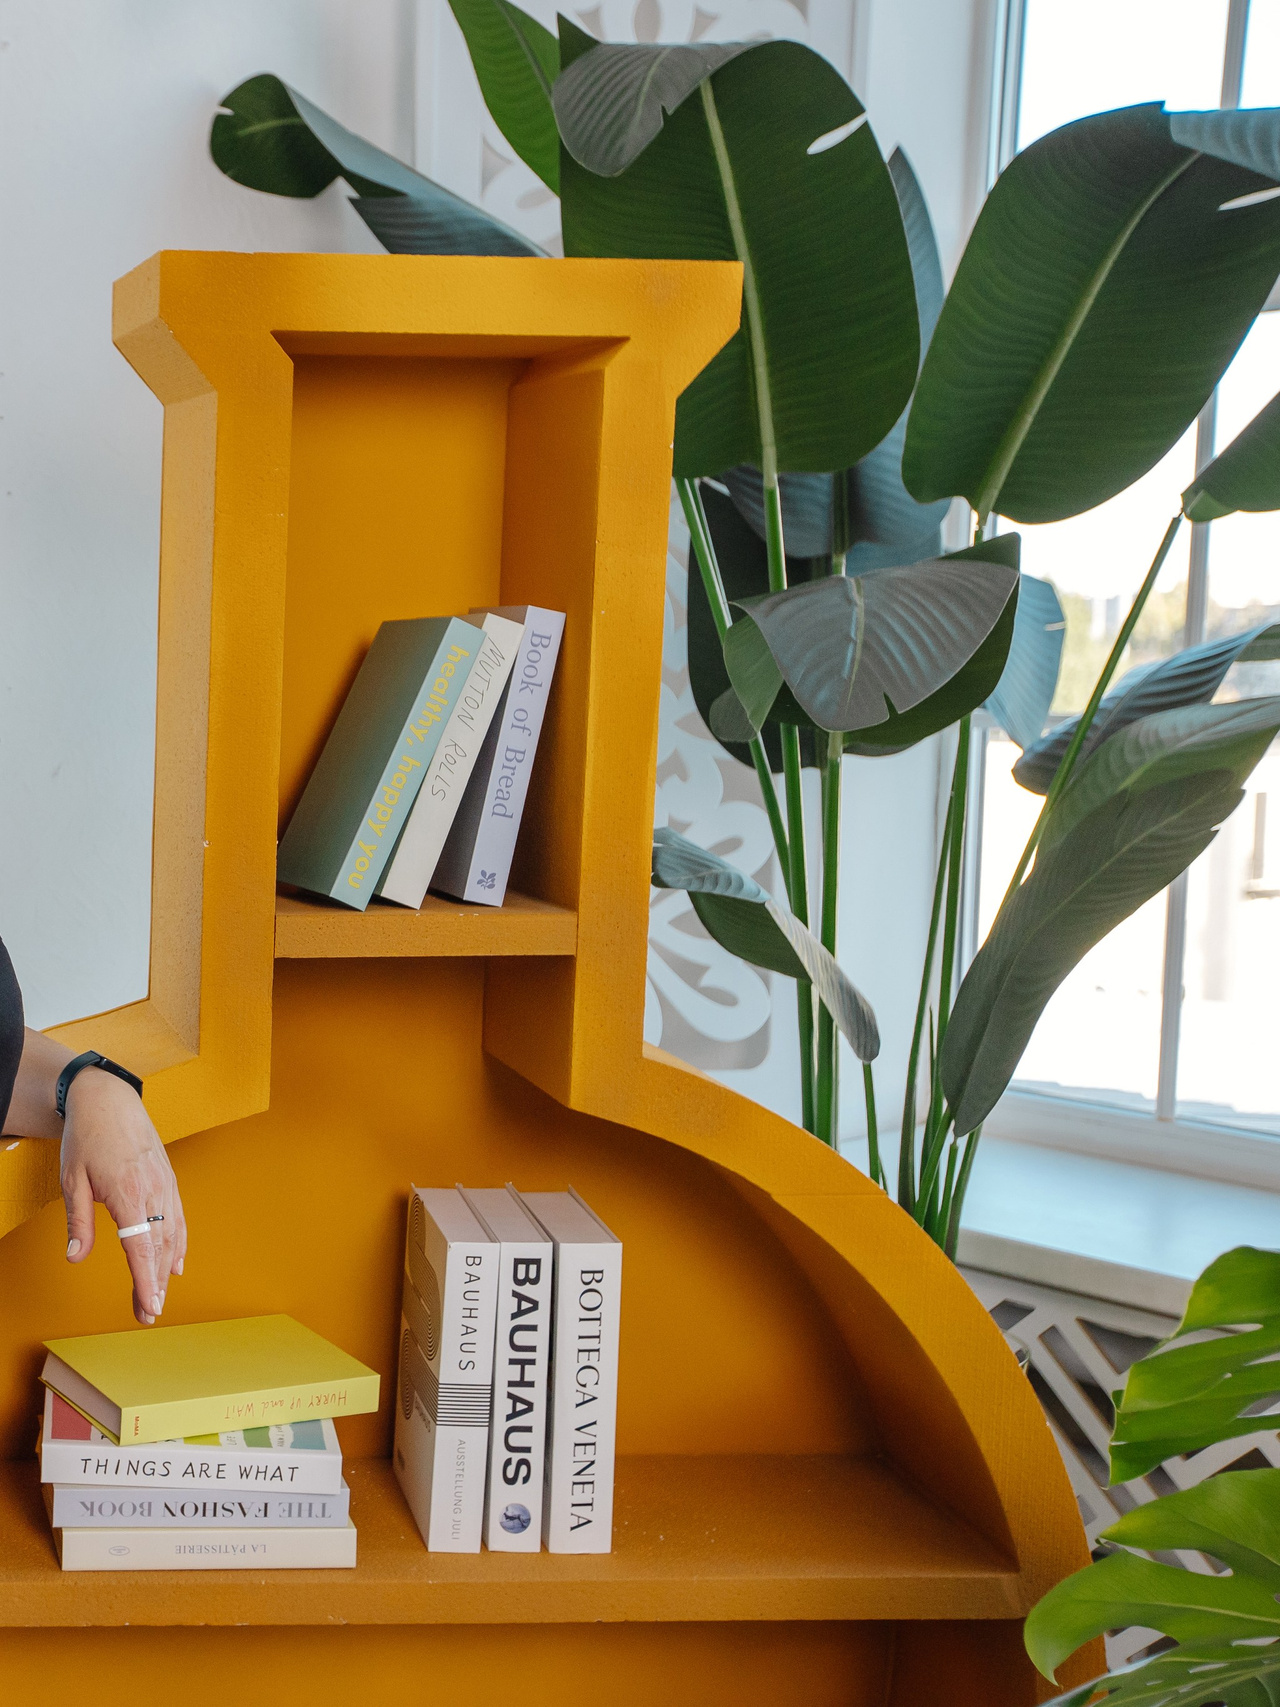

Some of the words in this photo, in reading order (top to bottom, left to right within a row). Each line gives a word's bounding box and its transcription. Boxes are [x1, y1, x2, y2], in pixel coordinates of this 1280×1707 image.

[457, 637, 505, 731] MUTTON
[519, 630, 552, 694] Book
[510, 708, 532, 737] of
[368, 755, 421, 837] happy
[431, 739, 467, 801] ROLLS
[491, 745, 526, 819] Bread
[347, 840, 378, 889] you
[458, 1255, 482, 1371] BAUHAUS
[575, 1269, 604, 1409] BOTTEGA
[290, 1396, 302, 1408] UP
[502, 1257, 542, 1487] BAUHAUS
[261, 1399, 285, 1418] and
[80, 1458, 172, 1477] THINGS
[182, 1462, 227, 1480] ARE
[238, 1464, 300, 1482] WHAT
[452, 1438, 467, 1515] AUSSTELLUNG
[570, 1421, 597, 1532] VENETA
[79, 1501, 152, 1518] BOOK
[277, 1501, 332, 1519] THE
[451, 1518, 462, 1540] JULI
[251, 1544, 267, 1554] LA
